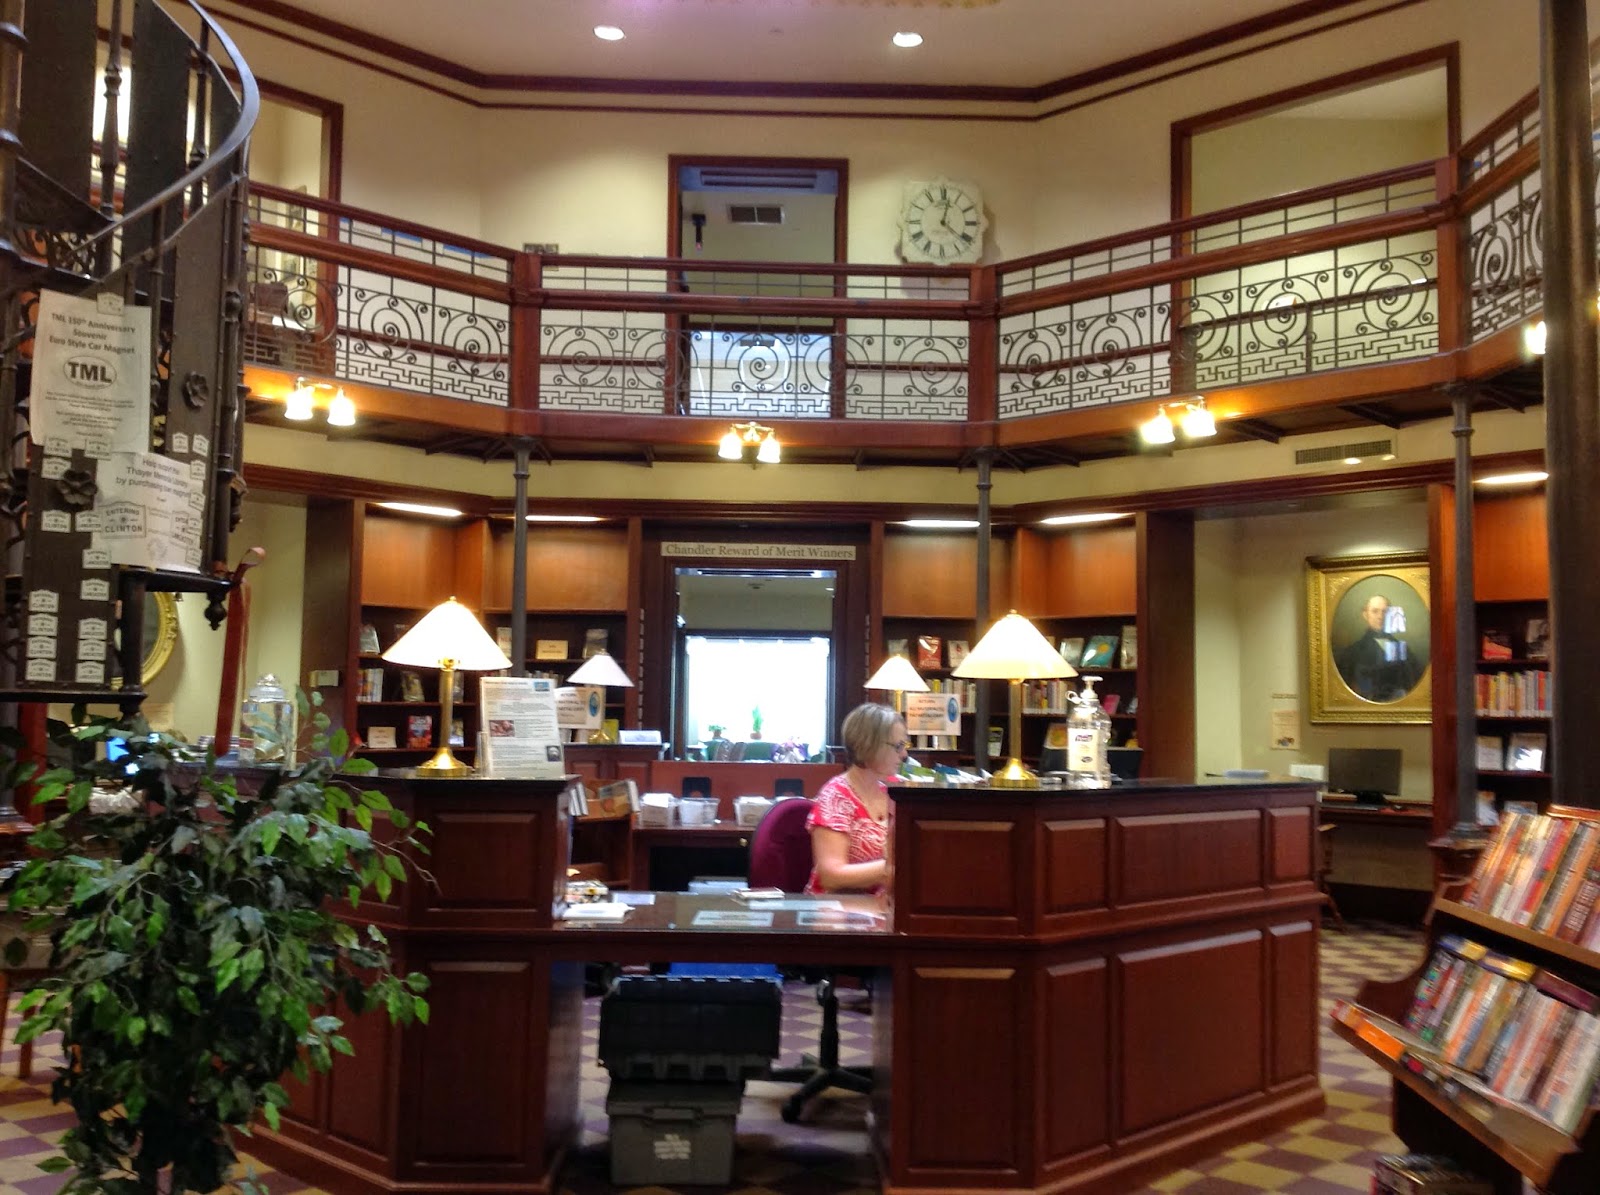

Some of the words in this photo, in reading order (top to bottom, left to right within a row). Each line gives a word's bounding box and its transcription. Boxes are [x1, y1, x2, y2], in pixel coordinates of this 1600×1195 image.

[88, 320, 136, 334] Anniversary
[73, 328, 107, 341] Souvenir
[49, 335, 66, 346] Euro
[67, 338, 87, 349] Style
[88, 342, 102, 351] Car
[103, 344, 135, 355] Magnet
[67, 361, 112, 384] TML
[105, 507, 140, 517] ENTERING
[104, 524, 143, 533] CLINTON
[665, 543, 715, 555] Chandler
[719, 545, 760, 556] Reward
[761, 546, 774, 556] of
[776, 546, 805, 557] Merit
[806, 547, 854, 559] Winners
